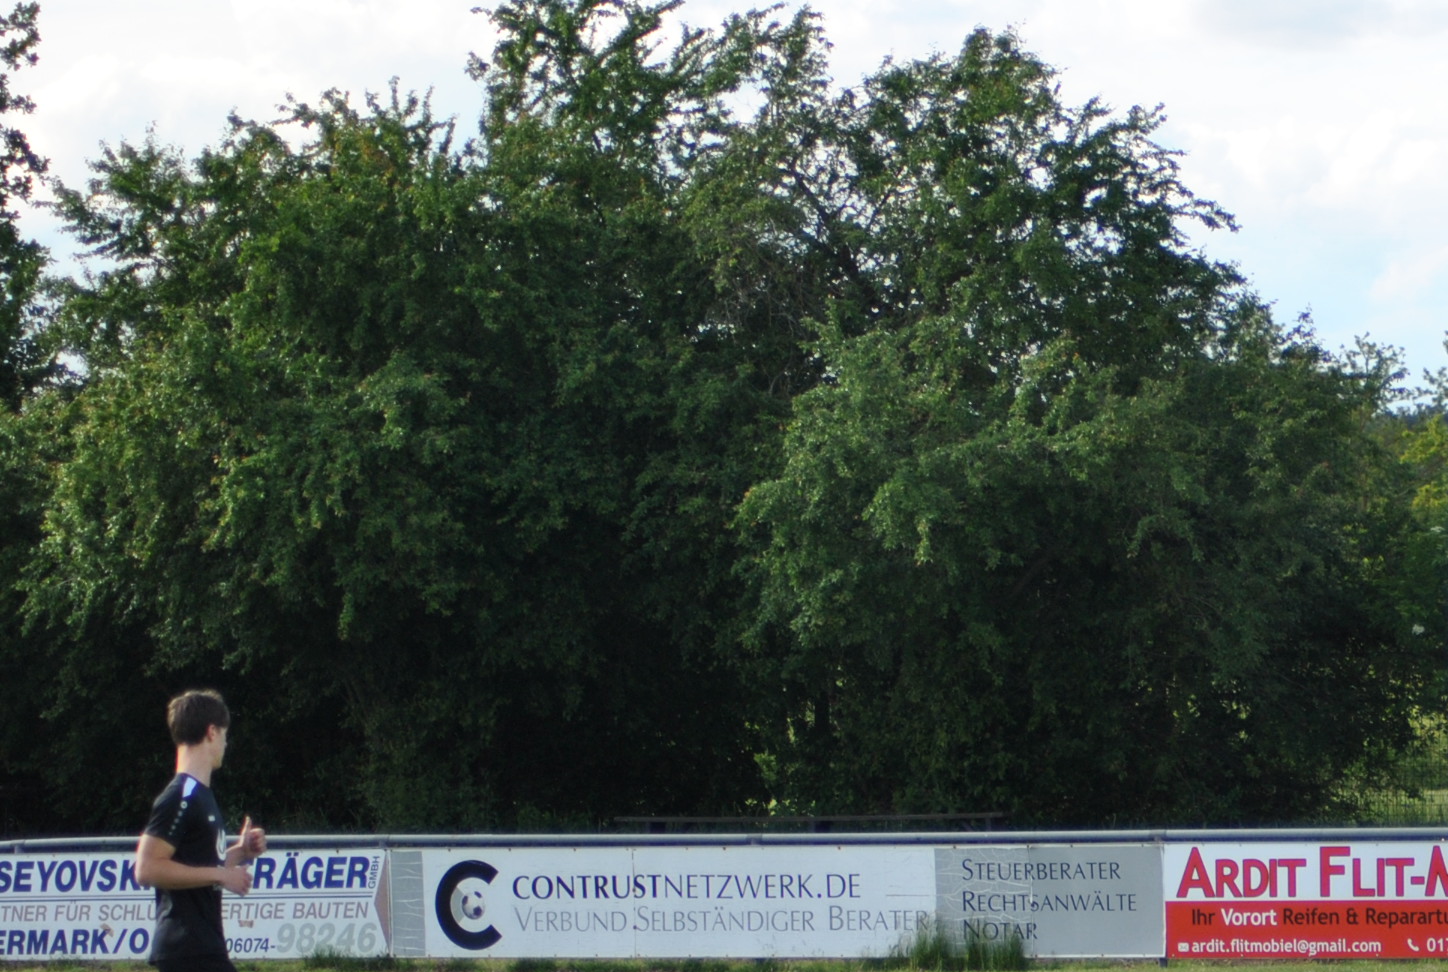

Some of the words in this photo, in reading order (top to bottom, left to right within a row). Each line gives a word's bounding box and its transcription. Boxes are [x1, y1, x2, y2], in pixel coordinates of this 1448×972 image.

[0, 859, 154, 894] SEYOVSK
[248, 851, 371, 890] RÄGER
[367, 855, 381, 890] GMBH
[961, 858, 1121, 881] STEUERBERATER
[1176, 847, 1307, 898] ARDIT
[512, 873, 861, 900] CONTRUSTNETZWERK.DE
[54, 900, 91, 921] FÜR
[292, 901, 369, 919] BAUTEN
[513, 906, 627, 933] VERBUND
[636, 905, 815, 932] SELBSTÄNDIGER
[829, 905, 929, 932] BERATER
[1192, 909, 1215, 925] Ihr
[1220, 908, 1277, 926] Vorort
[1283, 908, 1340, 925] Reifen
[1346, 908, 1359, 925] &
[962, 919, 1038, 941] NOTAR
[1191, 938, 1382, 956] ardit.flitmobiel@gmail.com
